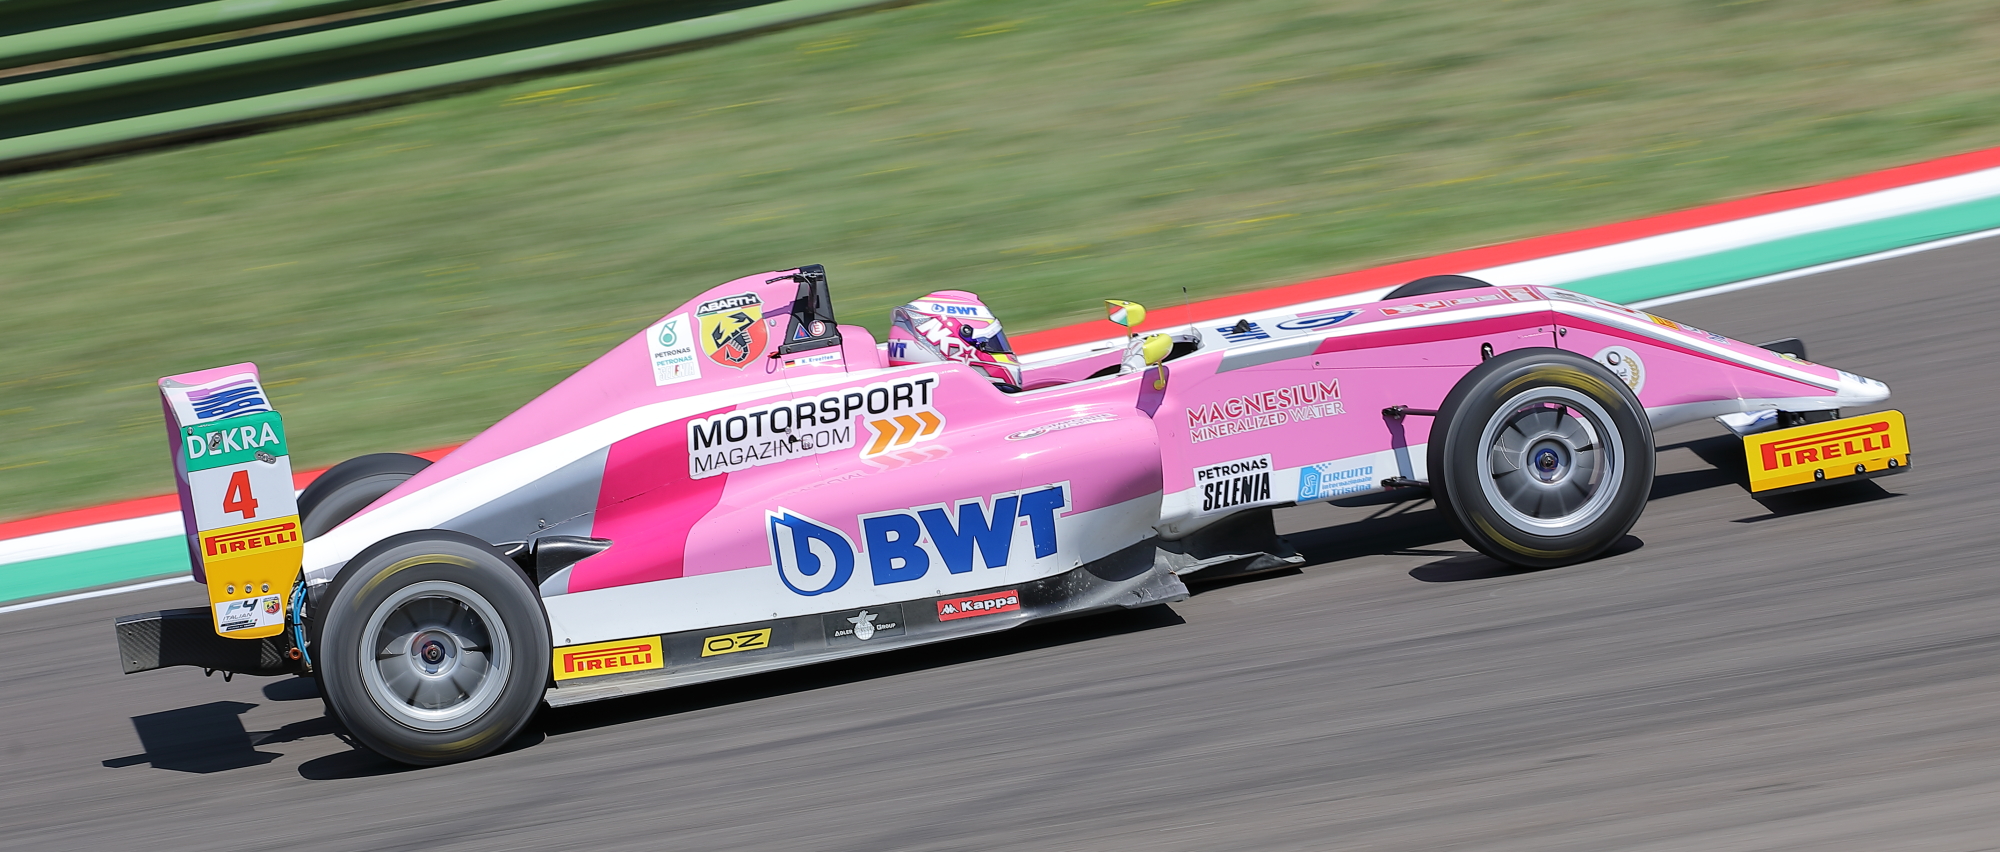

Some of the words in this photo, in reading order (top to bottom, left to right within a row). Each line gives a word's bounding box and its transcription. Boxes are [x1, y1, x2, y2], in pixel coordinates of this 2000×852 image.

[700, 293, 757, 313] ABARTH
[946, 305, 977, 315] BWT
[655, 347, 691, 358] PETRONAS
[657, 355, 693, 366] PETRONAS
[692, 378, 934, 450] MOTORSPORT
[1187, 379, 1340, 428] MAGNESIUM
[1191, 412, 1288, 443] MINERALIZED
[1290, 402, 1344, 421] WATER
[187, 422, 280, 459] DEKRA
[694, 426, 850, 474] MAGAZIN.COM
[1760, 421, 1891, 471] PIRELLI
[1198, 458, 1269, 481] PETRONAS
[1323, 466, 1373, 482] CIRCUITO
[223, 470, 258, 519] 4
[1203, 472, 1271, 511] SELENIA
[205, 523, 297, 557] PIRELLI
[863, 486, 1065, 586] BWT
[961, 595, 1018, 612] Kappa
[564, 644, 652, 673] PIRELLI
